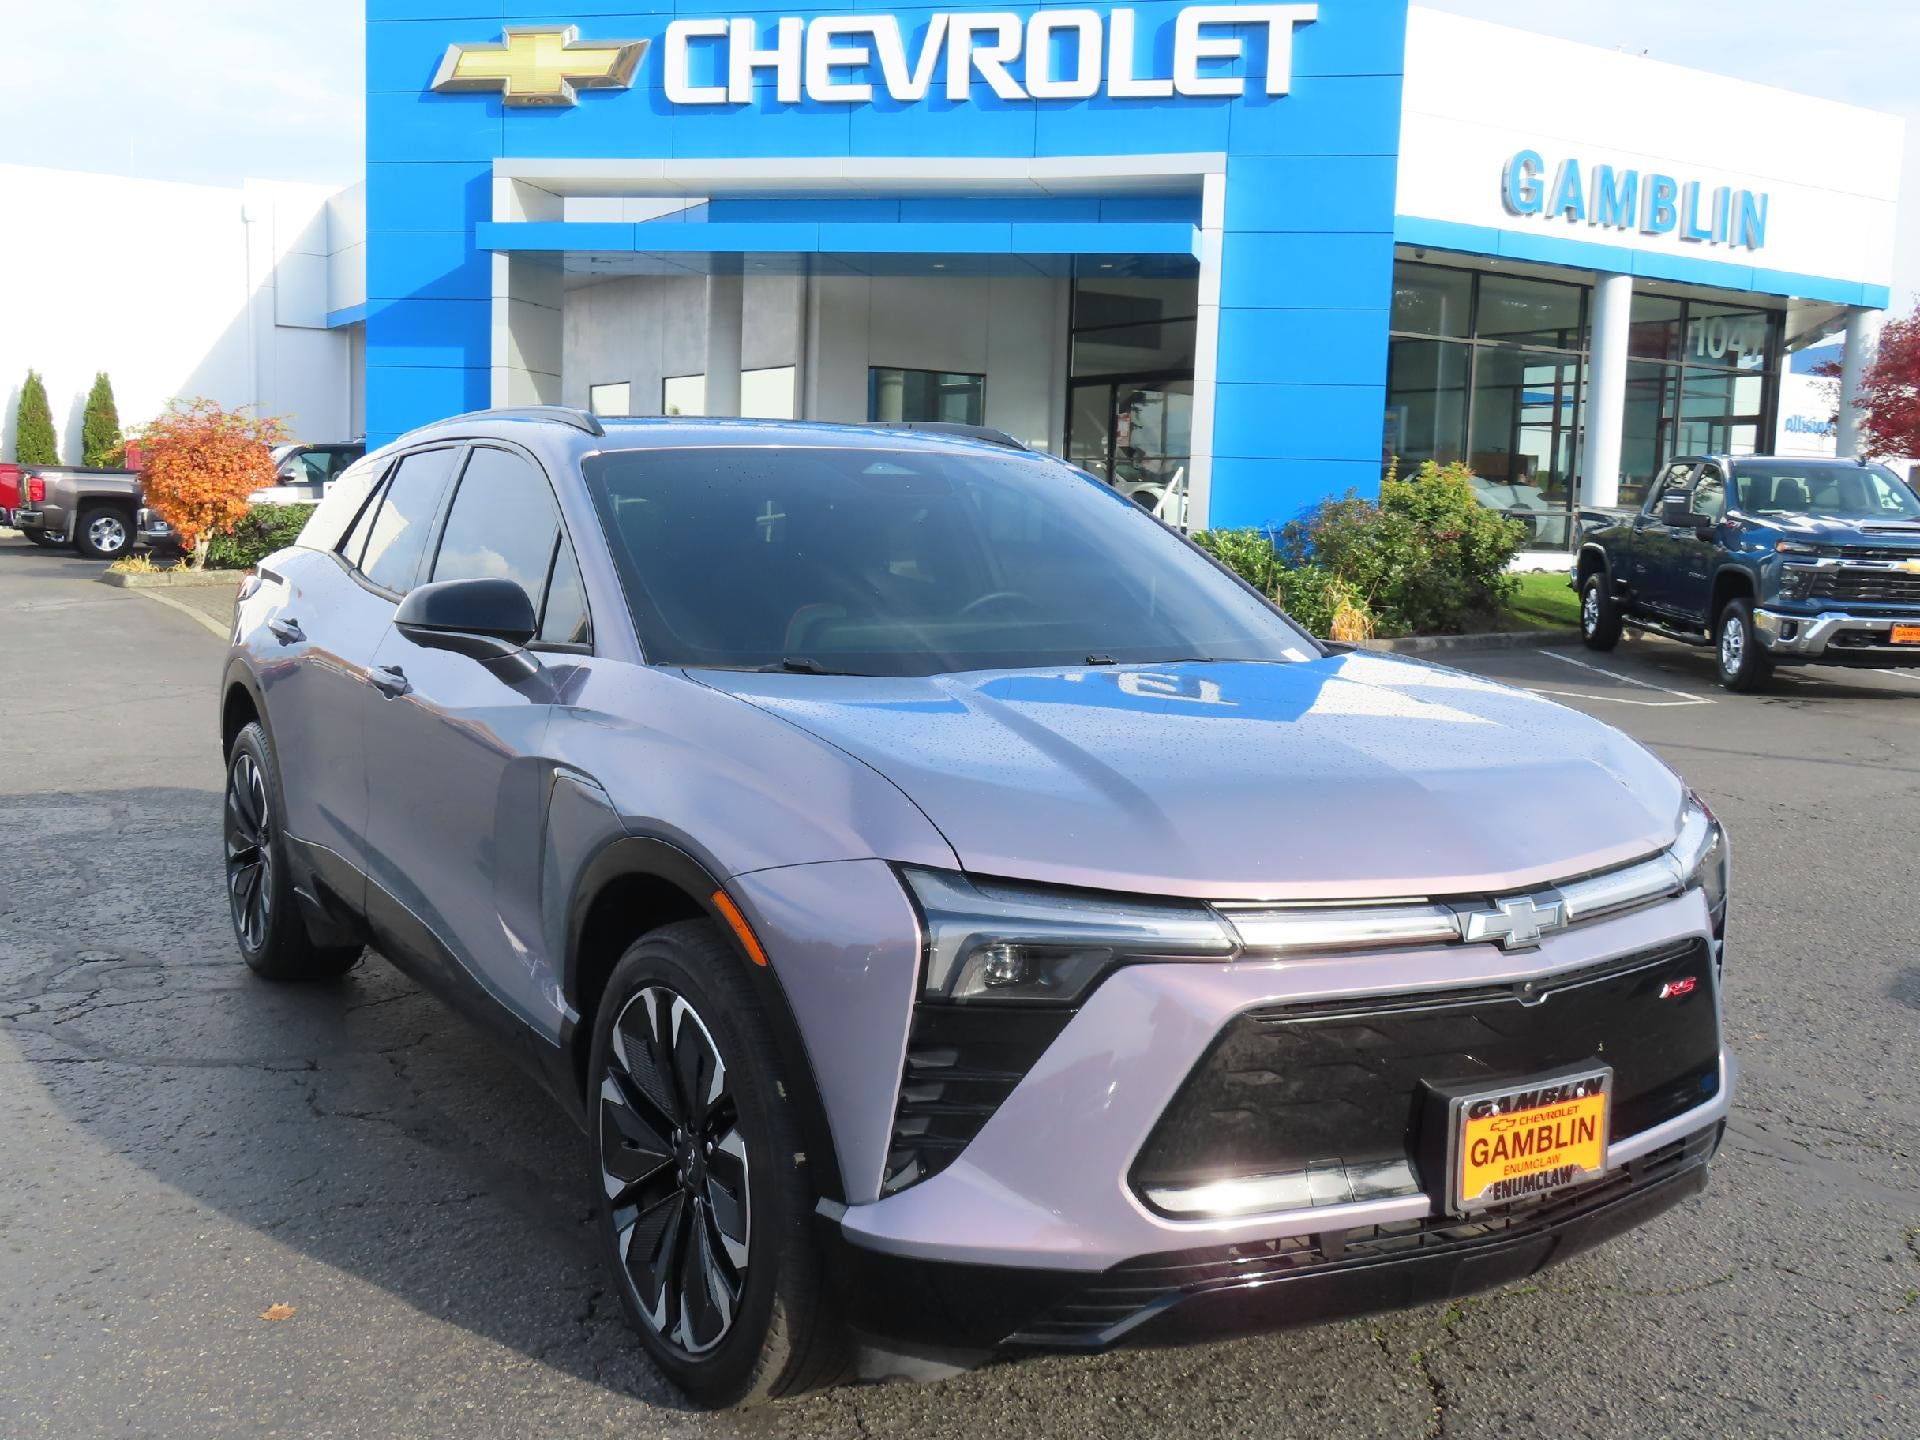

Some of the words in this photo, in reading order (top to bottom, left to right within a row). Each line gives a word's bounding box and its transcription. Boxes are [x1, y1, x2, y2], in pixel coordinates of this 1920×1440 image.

[663, 3, 1318, 104] CHEVROLET
[1501, 149, 1768, 250] GAMBLIN
[1659, 977, 1696, 999] RS
[1519, 1105, 1581, 1126] CHEVROLET
[1471, 1115, 1596, 1168] GAMBLIN
[1493, 1164, 1575, 1200] ENUMCLAW
[1503, 1153, 1562, 1176] ENUMCLAW
